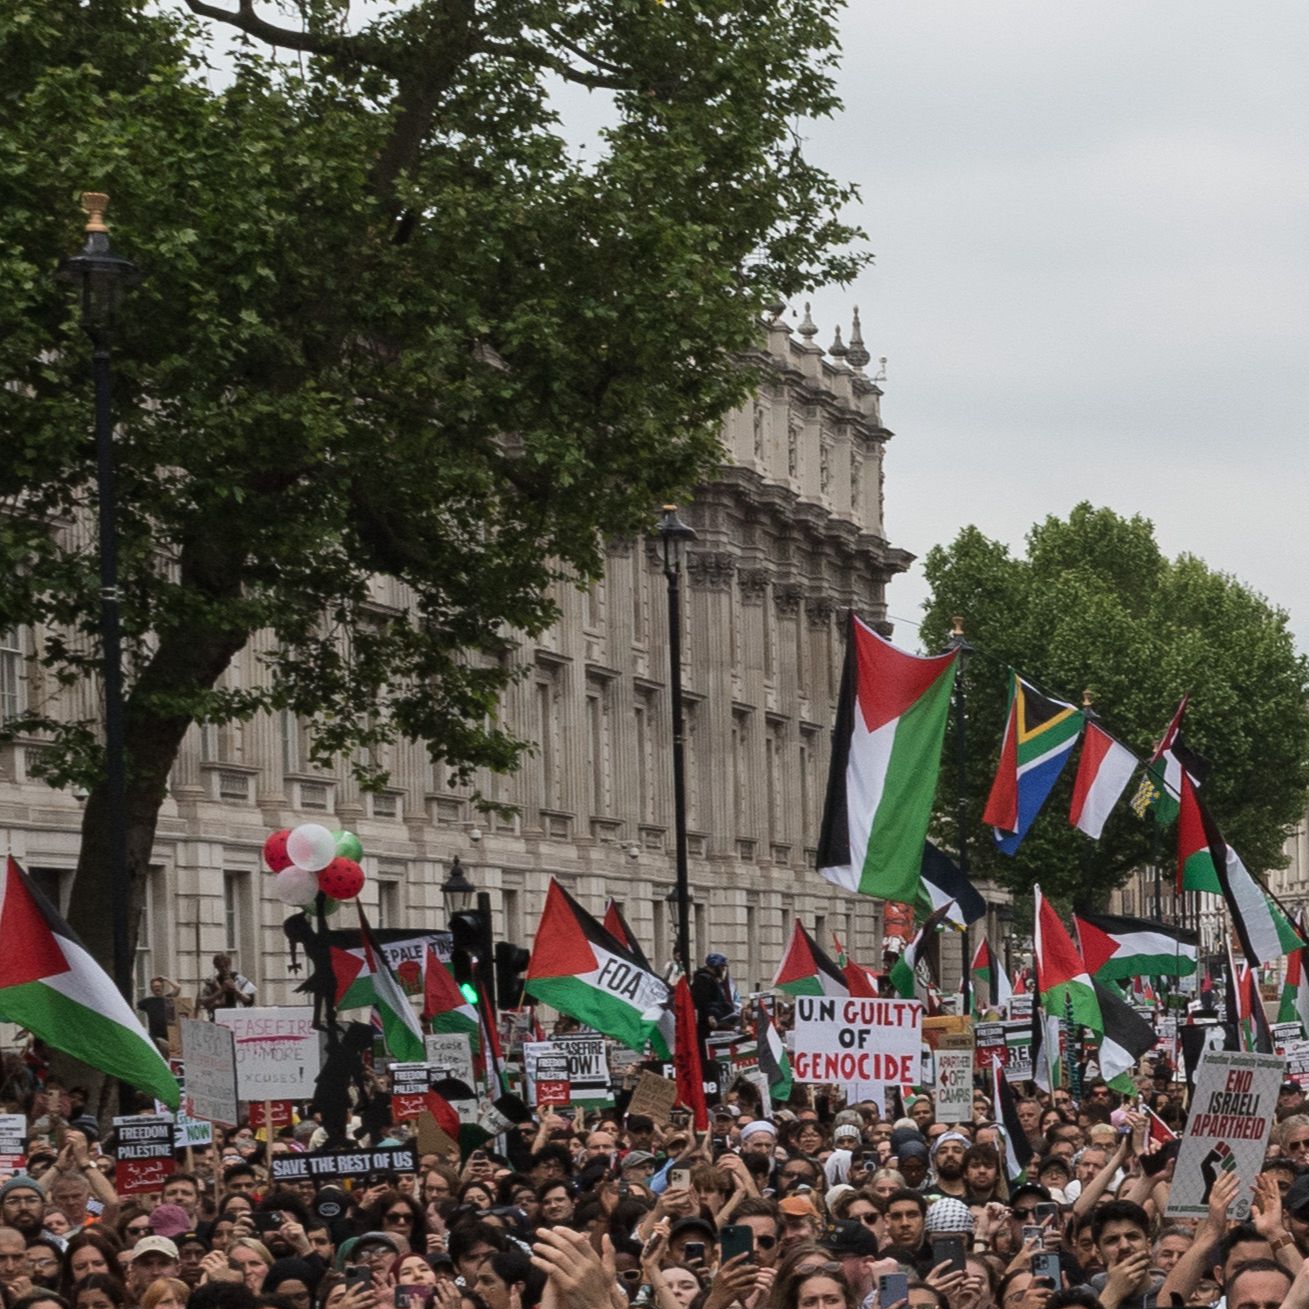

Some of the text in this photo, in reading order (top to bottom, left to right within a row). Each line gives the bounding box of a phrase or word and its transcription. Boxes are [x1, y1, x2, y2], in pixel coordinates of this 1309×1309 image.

[596, 957, 645, 1001] FOA
[798, 998, 922, 1028] U.N GUILTY
[838, 1027, 871, 1049] OF
[568, 1055, 601, 1075] OW!
[795, 1052, 915, 1083] GENOCIDE
[949, 1070, 966, 1087] OFF
[1225, 1069, 1254, 1093] END
[939, 1088, 971, 1104] CAMPUS
[1207, 1091, 1261, 1117] ISRAELI
[119, 1125, 169, 1141] FREEDOM
[186, 1123, 211, 1142] NOW
[1190, 1113, 1266, 1140] APARTHEID
[117, 1143, 172, 1160] PALESTINE
[272, 1150, 414, 1176] SAVE THE REST OF US
